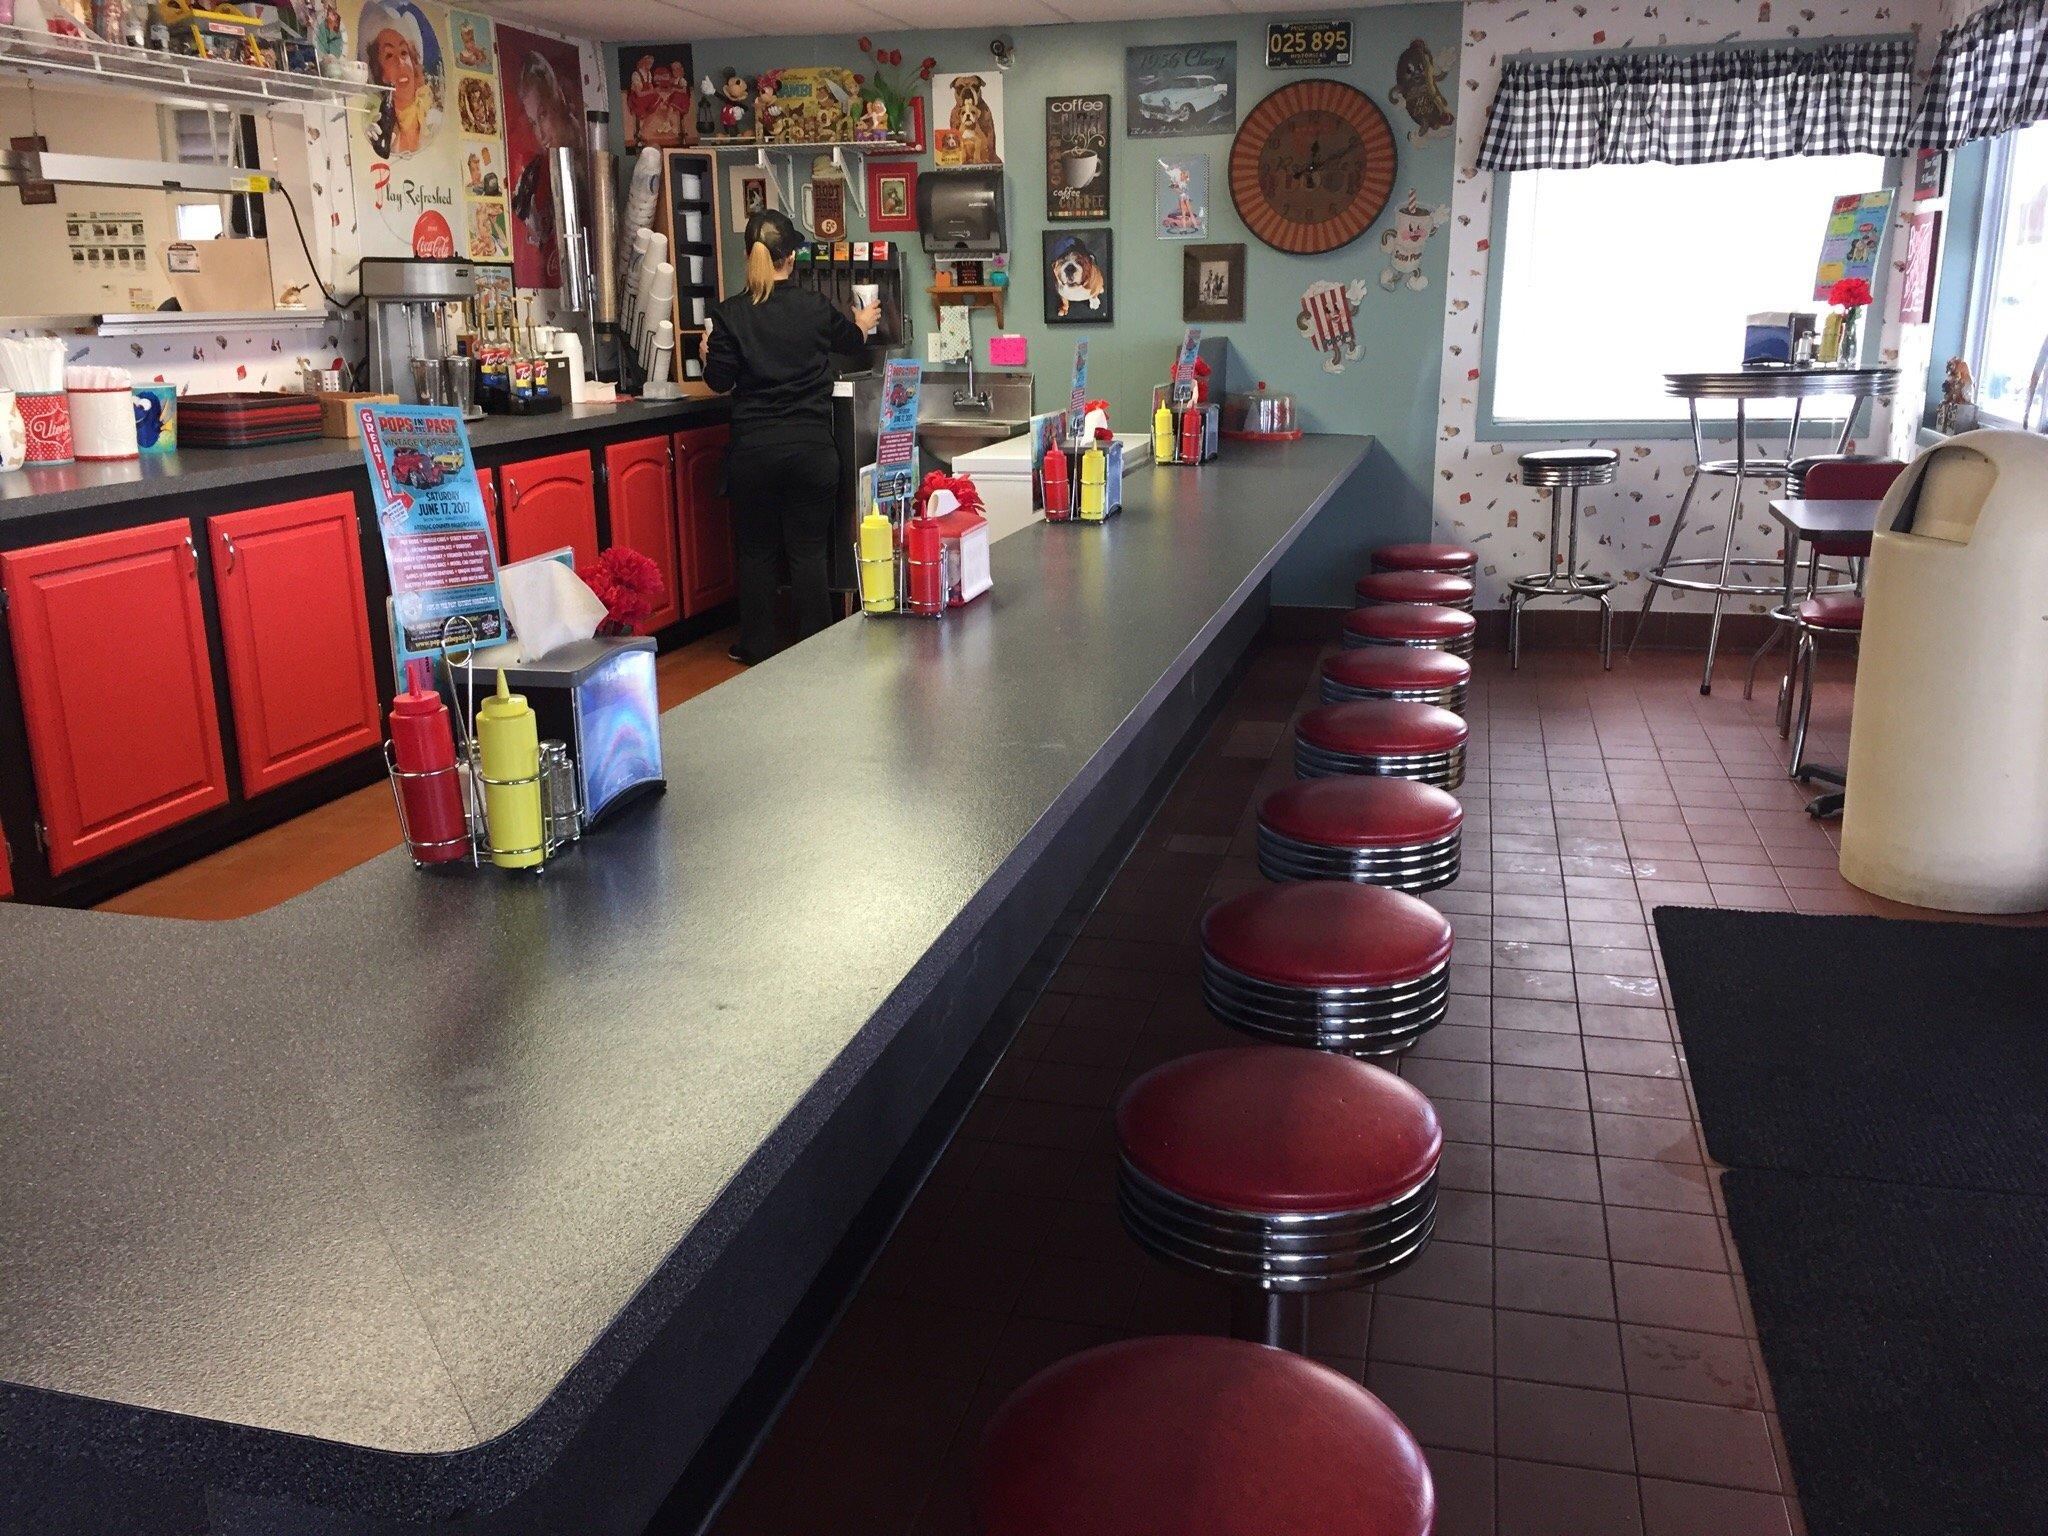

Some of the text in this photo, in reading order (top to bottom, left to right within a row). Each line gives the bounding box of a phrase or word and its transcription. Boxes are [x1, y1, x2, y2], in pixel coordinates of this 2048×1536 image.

[1270, 31, 1347, 53] 025 895
[1141, 48, 1225, 70] 1956 Chevy
[1051, 99, 1104, 113] coffee
[369, 163, 452, 213] Play Refreshed
[1053, 186, 1081, 200] coffee
[378, 416, 414, 433] POPS
[425, 418, 457, 433] PAST
[362, 413, 393, 500] GREAT FUN
[426, 491, 460, 502] SATURDAY
[418, 502, 441, 516] JUNE
[441, 502, 451, 516] 17,
[452, 501, 470, 514] 2017
